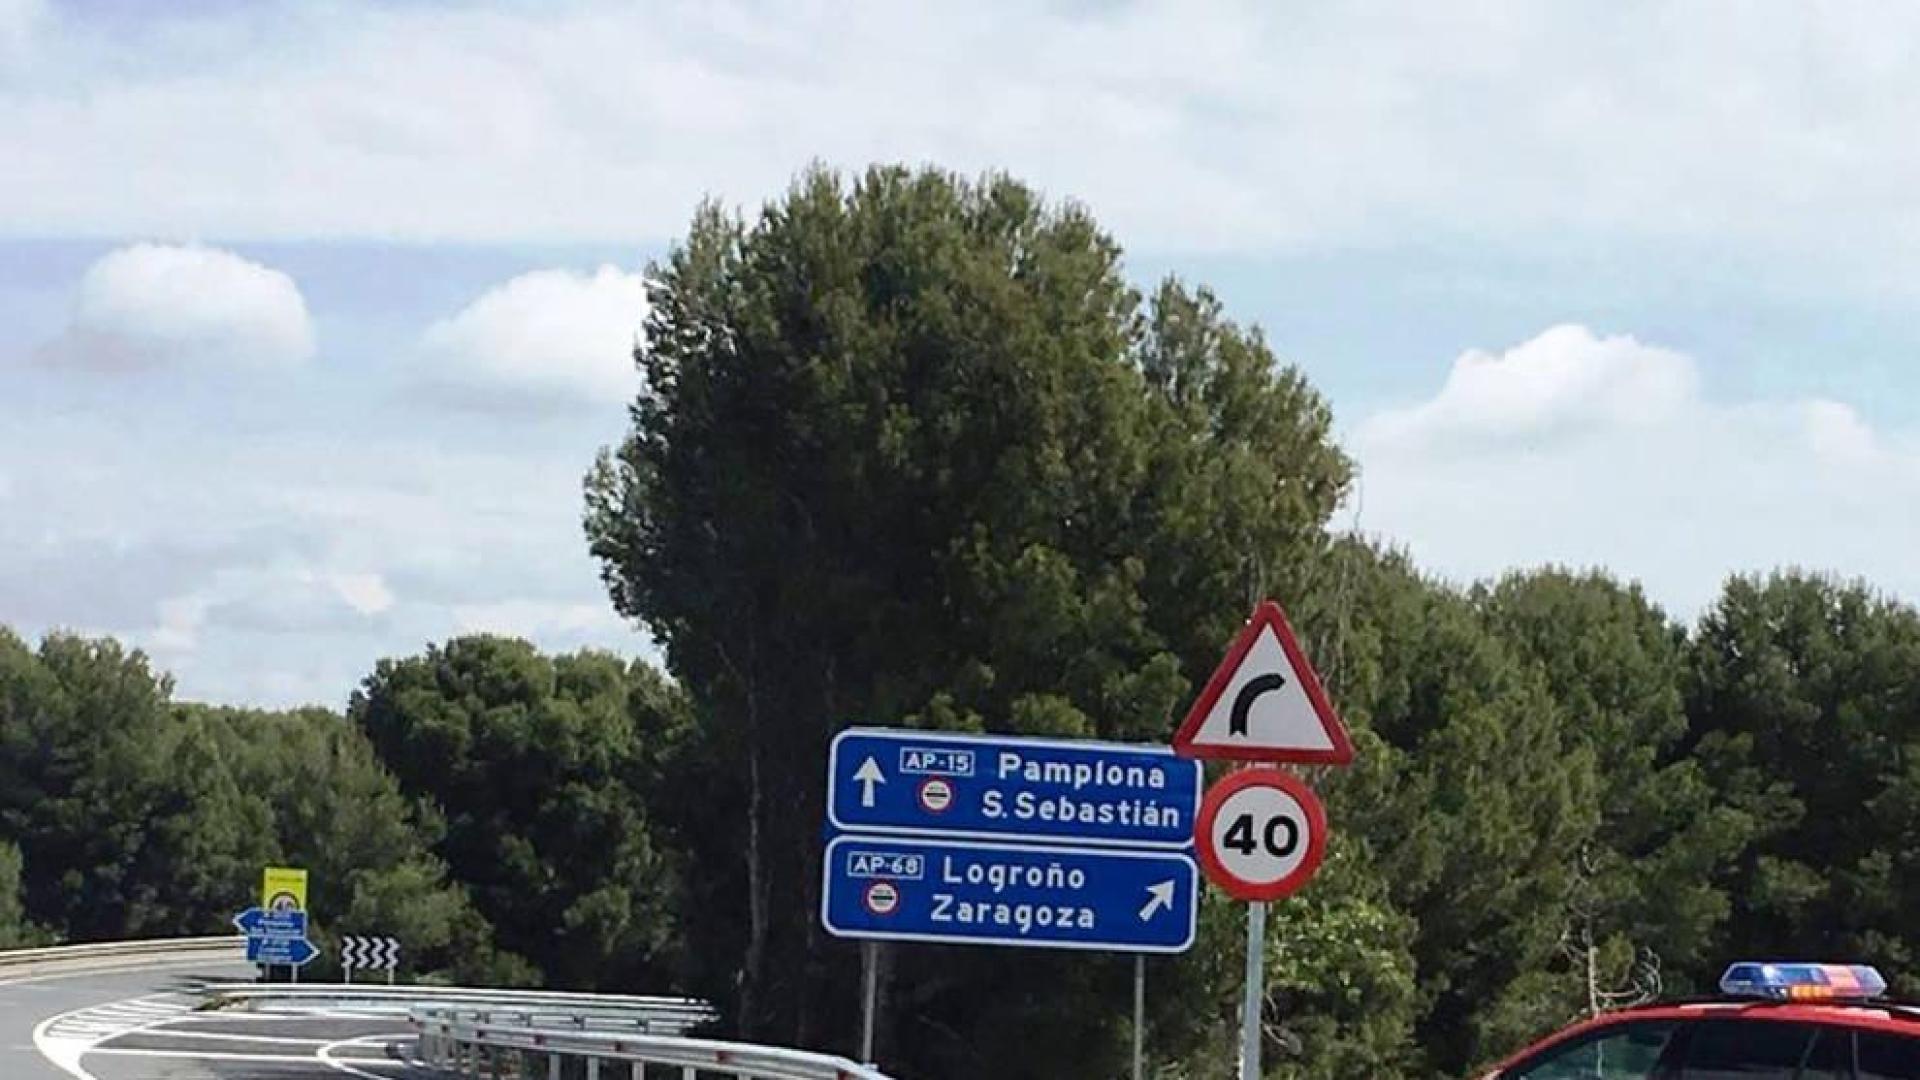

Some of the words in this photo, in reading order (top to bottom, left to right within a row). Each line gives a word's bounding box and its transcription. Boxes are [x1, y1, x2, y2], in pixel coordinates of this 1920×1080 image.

[905, 752, 969, 772] AP-15
[998, 752, 1165, 790] Pamplona
[1223, 814, 1299, 857] 40
[853, 856, 919, 875] AP-68
[943, 856, 1086, 893] Logroño
[931, 894, 1095, 933] Zaragoza
